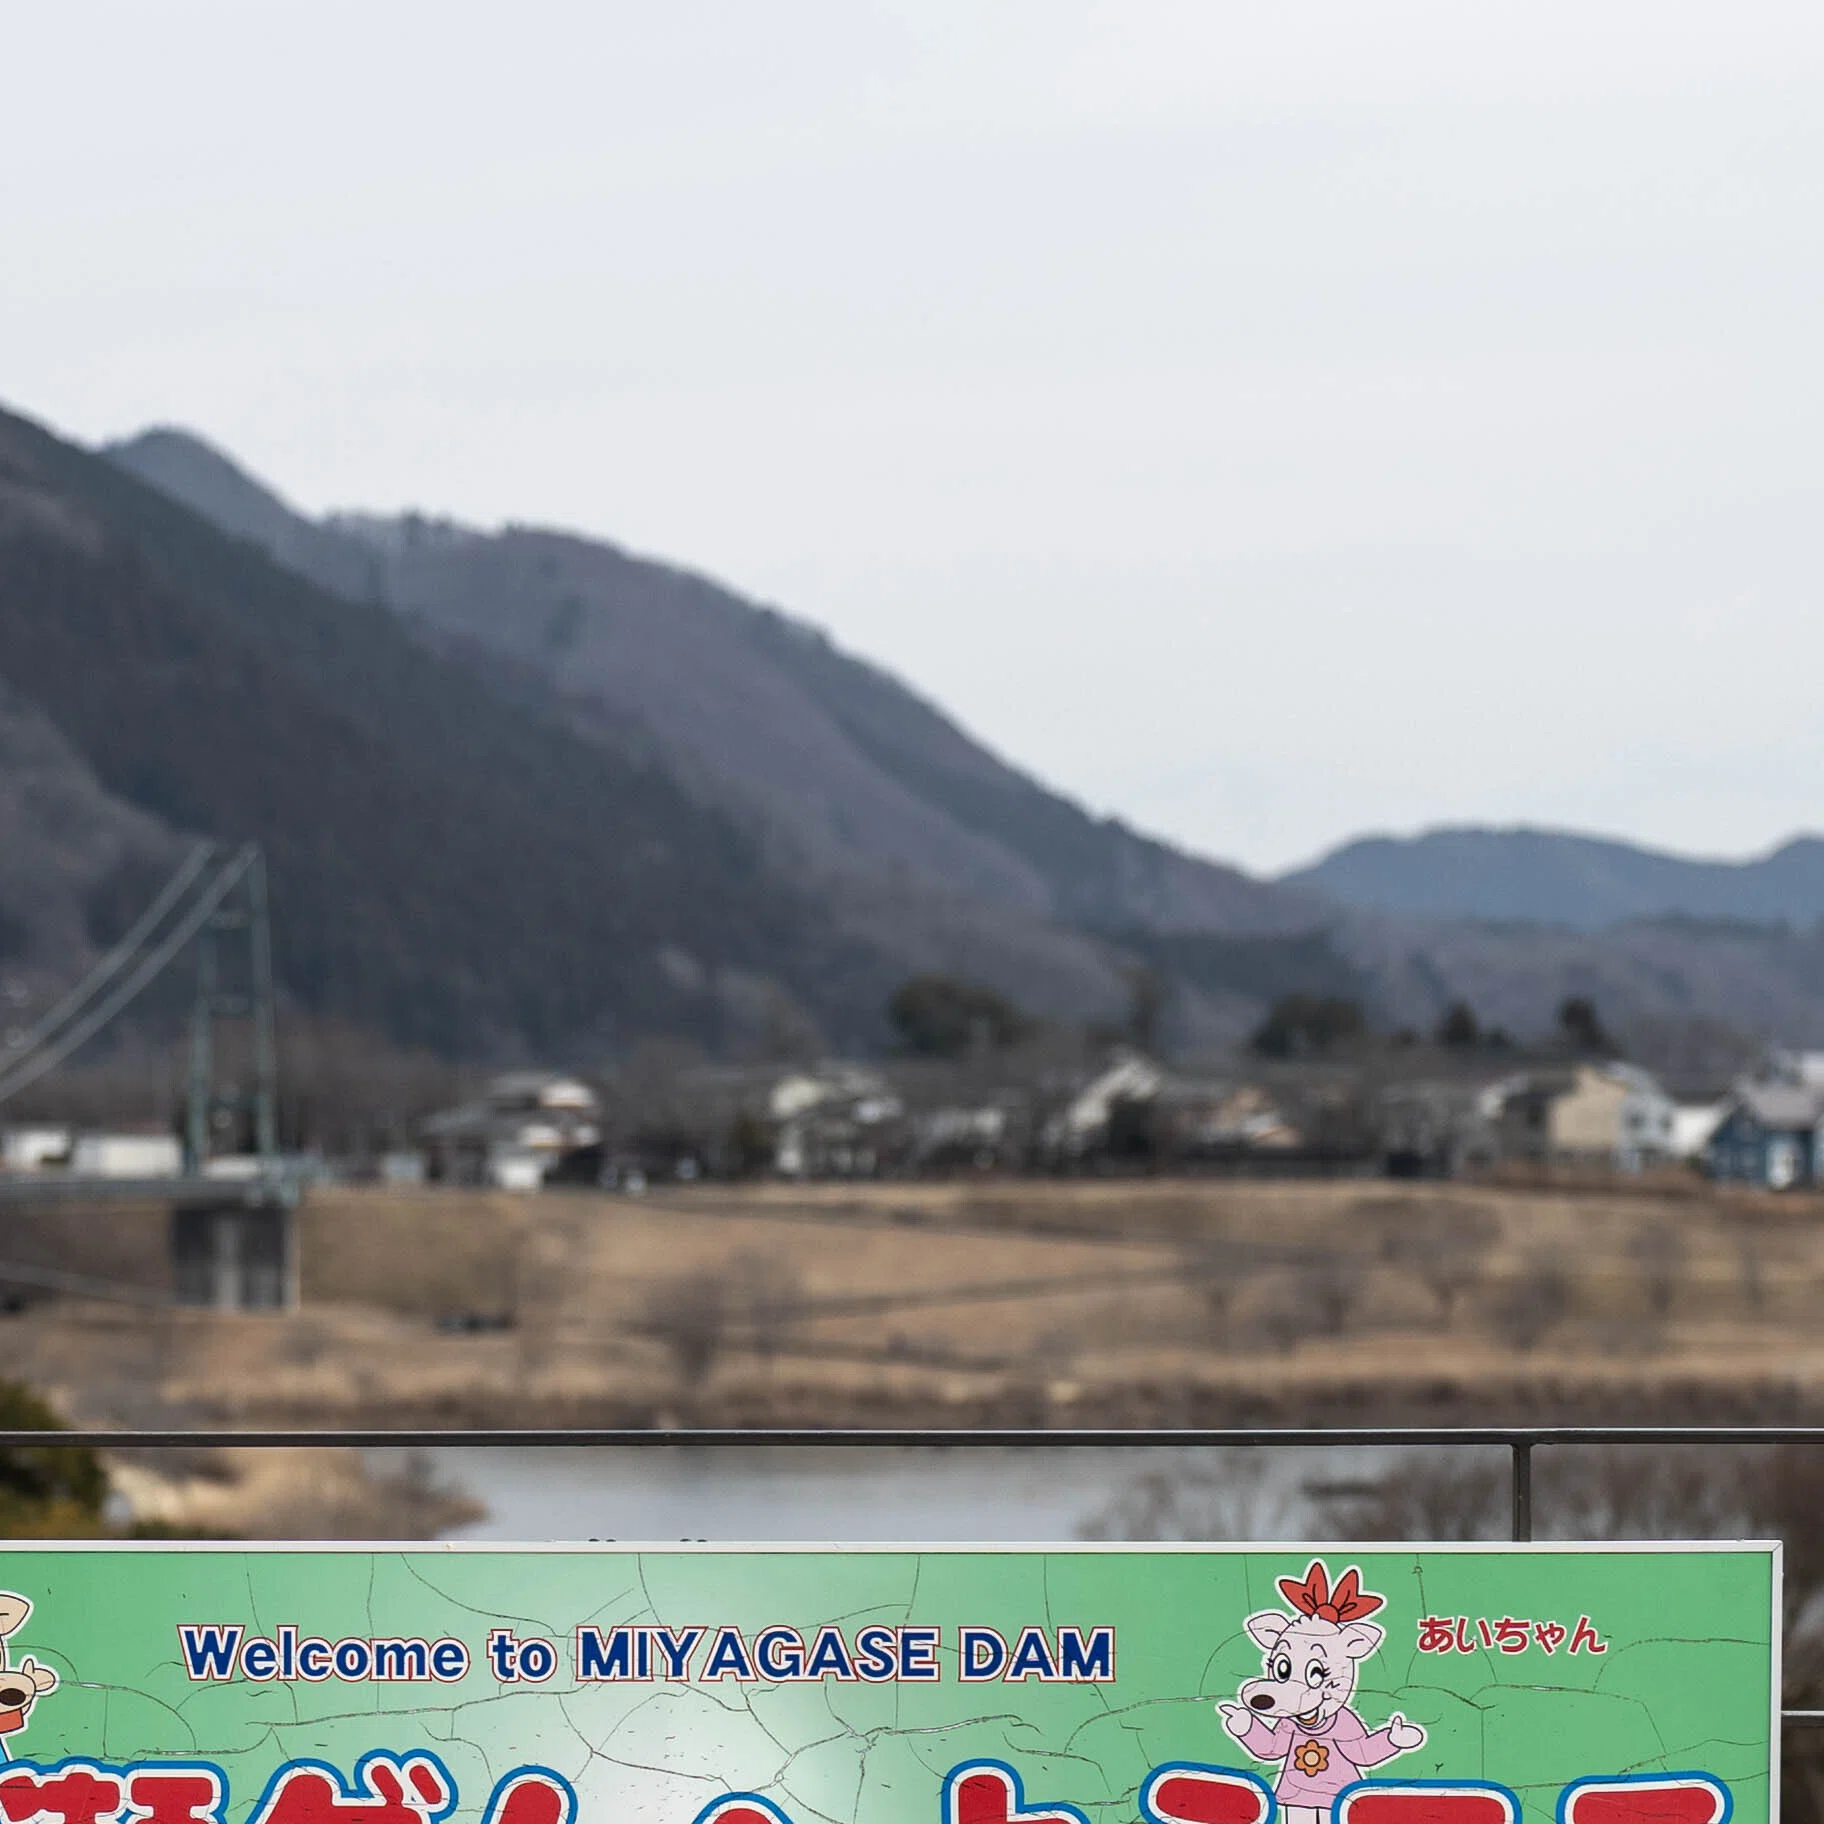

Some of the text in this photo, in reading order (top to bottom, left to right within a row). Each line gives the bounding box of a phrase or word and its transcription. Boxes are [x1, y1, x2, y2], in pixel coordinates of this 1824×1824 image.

[178, 1625, 1116, 1682] Welcome to MIYAGASE DAM
[1416, 1614, 1608, 1656] あいちゃん
